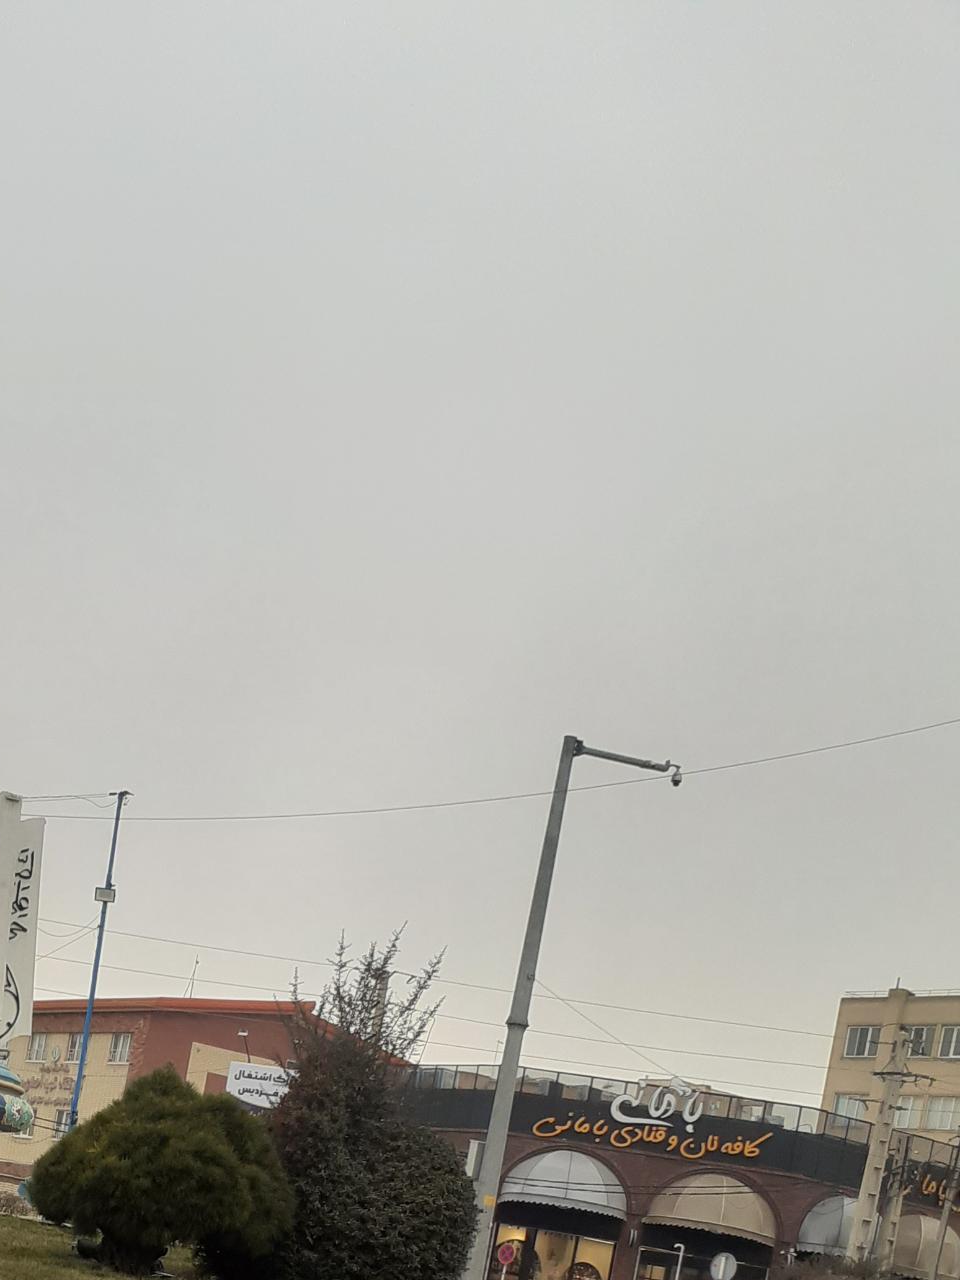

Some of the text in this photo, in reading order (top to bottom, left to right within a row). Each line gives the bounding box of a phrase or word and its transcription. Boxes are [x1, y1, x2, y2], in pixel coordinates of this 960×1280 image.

[234, 1069, 273, 1082] اشتغال
[237, 1086, 279, 1098] فردیس
[609, 1122, 668, 1148] قنادی
[679, 1134, 719, 1159] نان
[720, 1132, 774, 1158] کافه
